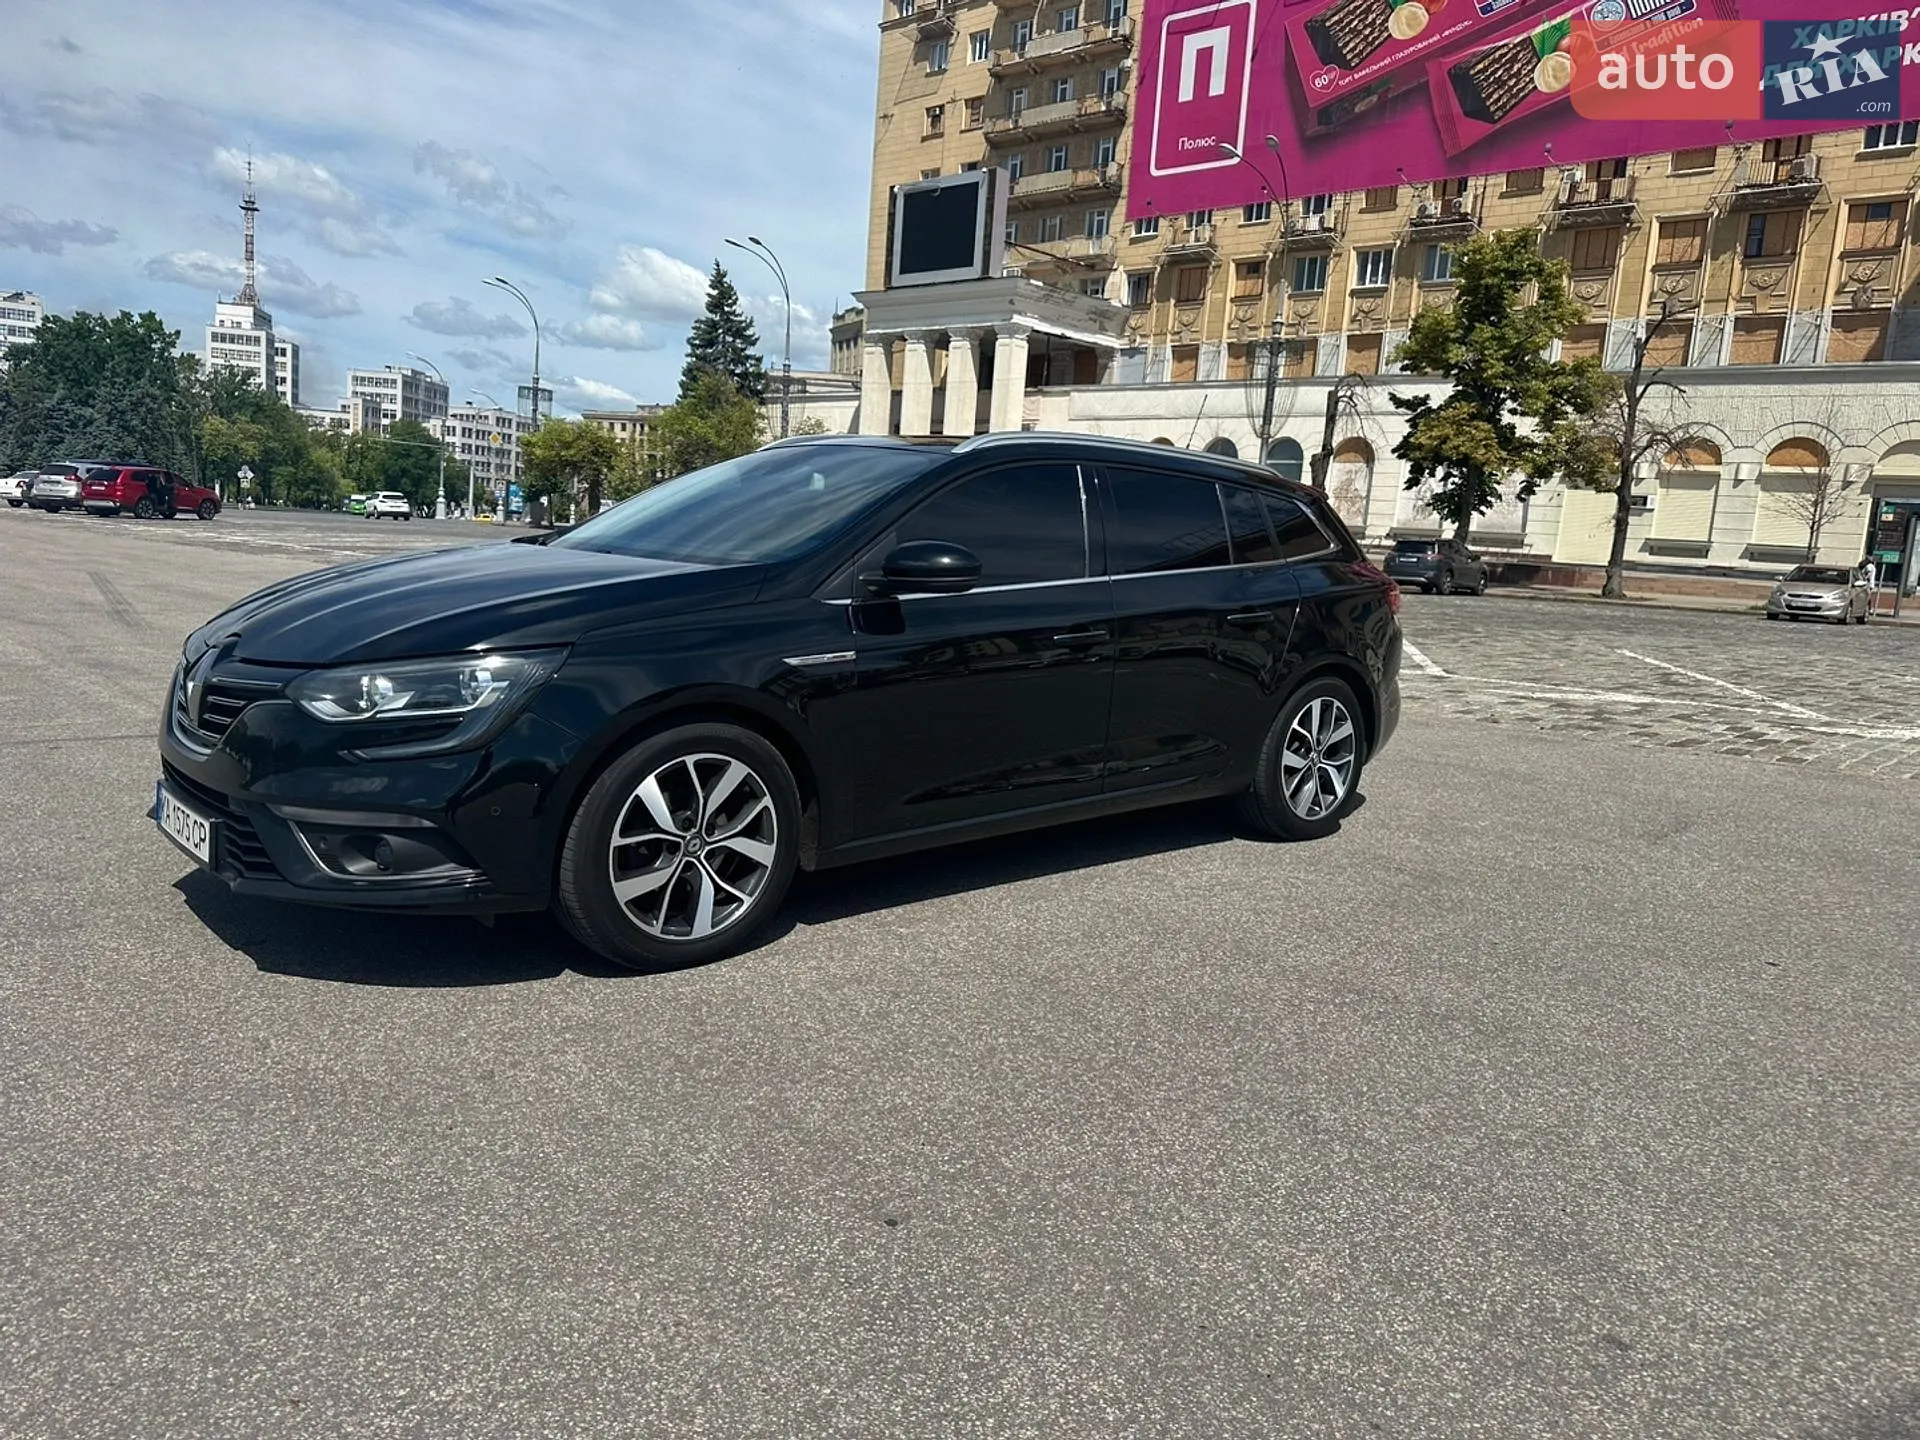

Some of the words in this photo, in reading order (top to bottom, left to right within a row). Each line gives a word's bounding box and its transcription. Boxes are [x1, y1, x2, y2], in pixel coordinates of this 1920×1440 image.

[1178, 25, 1231, 103] П
[1178, 136, 1217, 151] Полюс
[173, 803, 191, 843] 1575
[192, 819, 207, 852] CP
